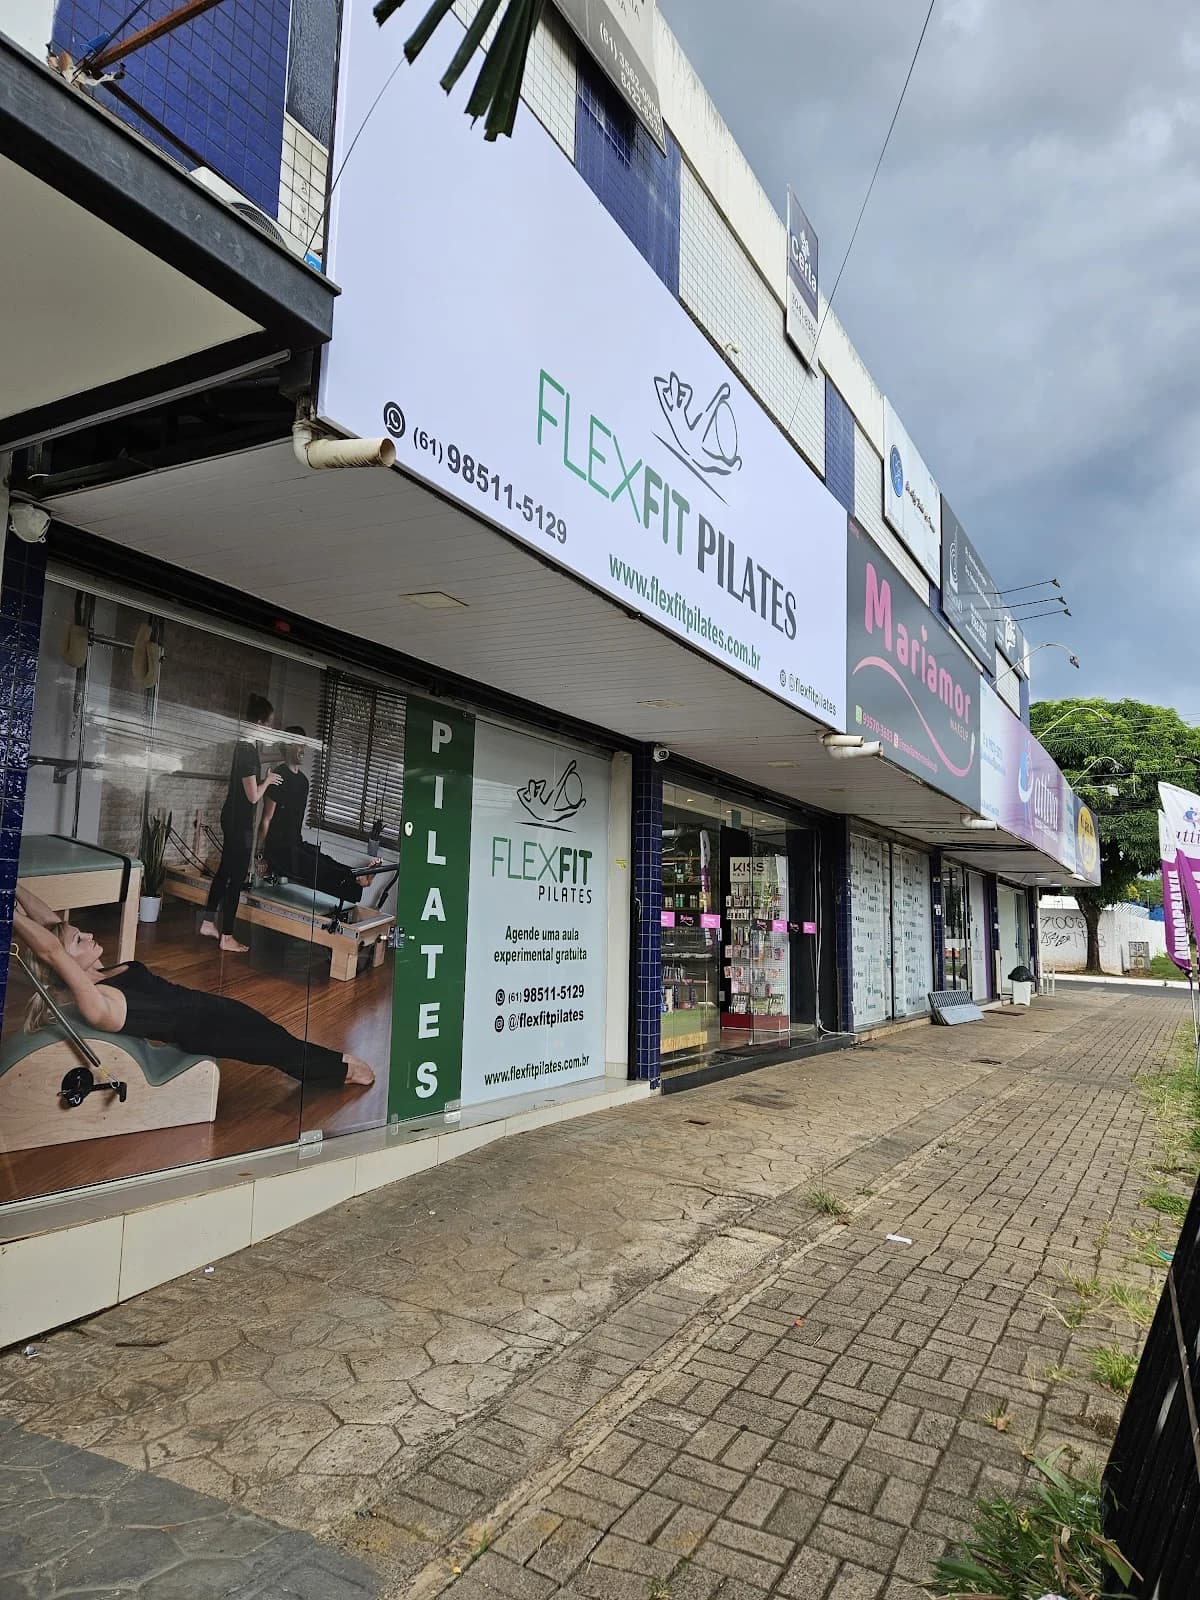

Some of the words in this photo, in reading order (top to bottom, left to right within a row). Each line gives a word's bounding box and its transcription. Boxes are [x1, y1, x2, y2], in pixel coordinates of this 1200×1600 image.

[791, 235, 817, 294] Certa
[413, 427, 443, 464] (61)
[447, 444, 567, 544] 98511-5129
[537, 368, 691, 556] FLEXFIT
[697, 512, 797, 641] PILATES
[609, 554, 761, 671] www.flexfitpilates.com.br
[864, 563, 971, 724] Mariamor
[491, 836, 593, 886] FLEXFIT
[733, 862, 765, 873] KISS
[415, 719, 453, 1100] PILATES
[538, 885, 592, 904] PILATES
[505, 925, 540, 944] Agende
[542, 929, 560, 941] uma
[562, 927, 579, 941] aula
[494, 947, 554, 965] experimental
[556, 946, 587, 964] gratuita
[508, 992, 522, 1004] (61)
[523, 984, 585, 1003] 98511-5129
[508, 1008, 584, 1031] @flexfitpilates
[484, 1053, 590, 1086] www.flexfitpilates.com.br
